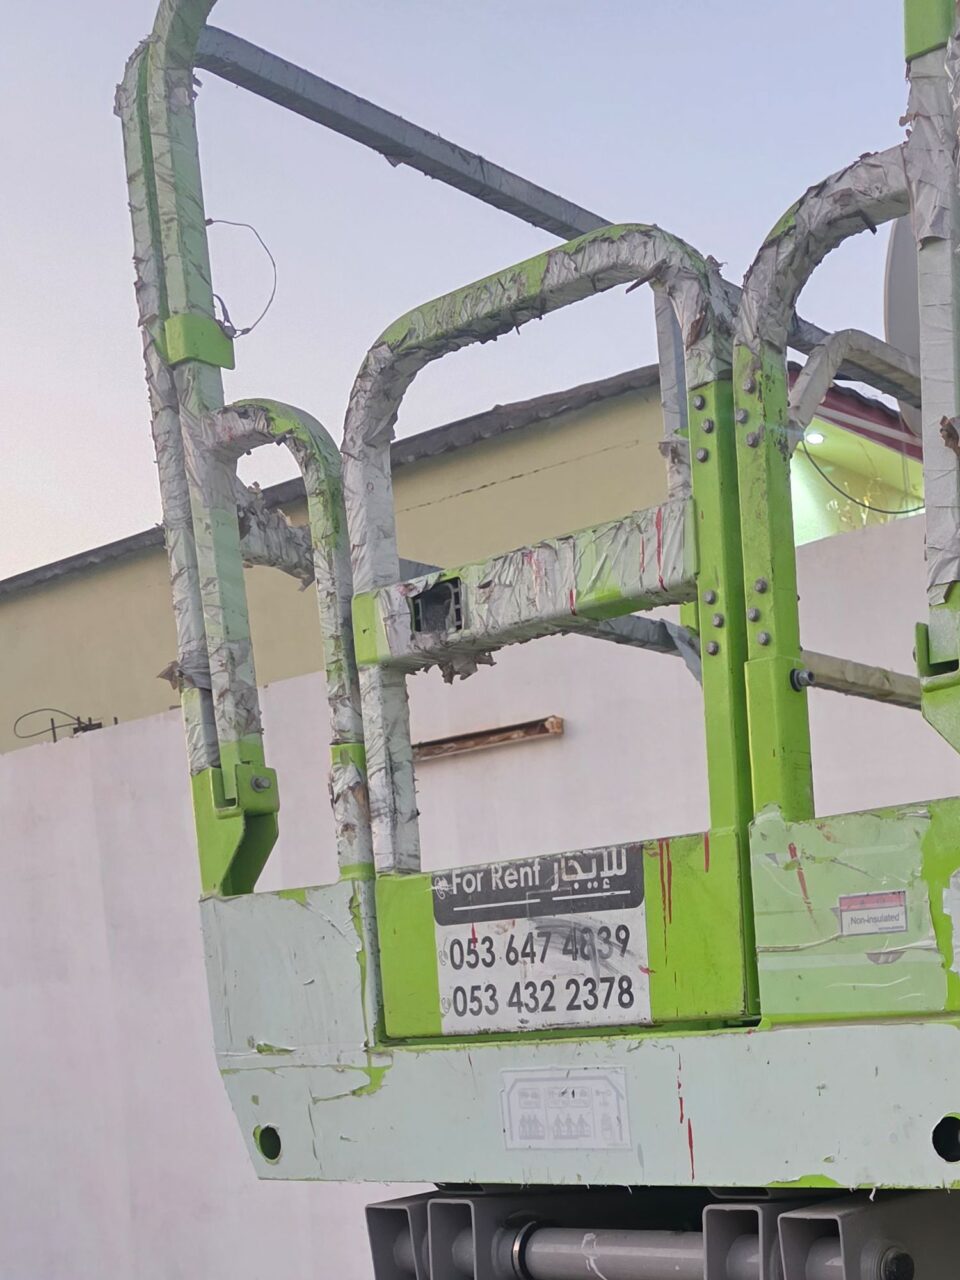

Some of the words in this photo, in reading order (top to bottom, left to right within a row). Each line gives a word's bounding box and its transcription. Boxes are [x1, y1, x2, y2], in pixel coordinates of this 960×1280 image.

[452, 869, 483, 895] For
[491, 859, 540, 890] Rent
[551, 848, 627, 891] للإيجار
[450, 936, 496, 970] 053
[505, 932, 551, 966] 647
[453, 984, 498, 1017] 053
[508, 980, 556, 1013] 432
[565, 975, 634, 1010] 2378
